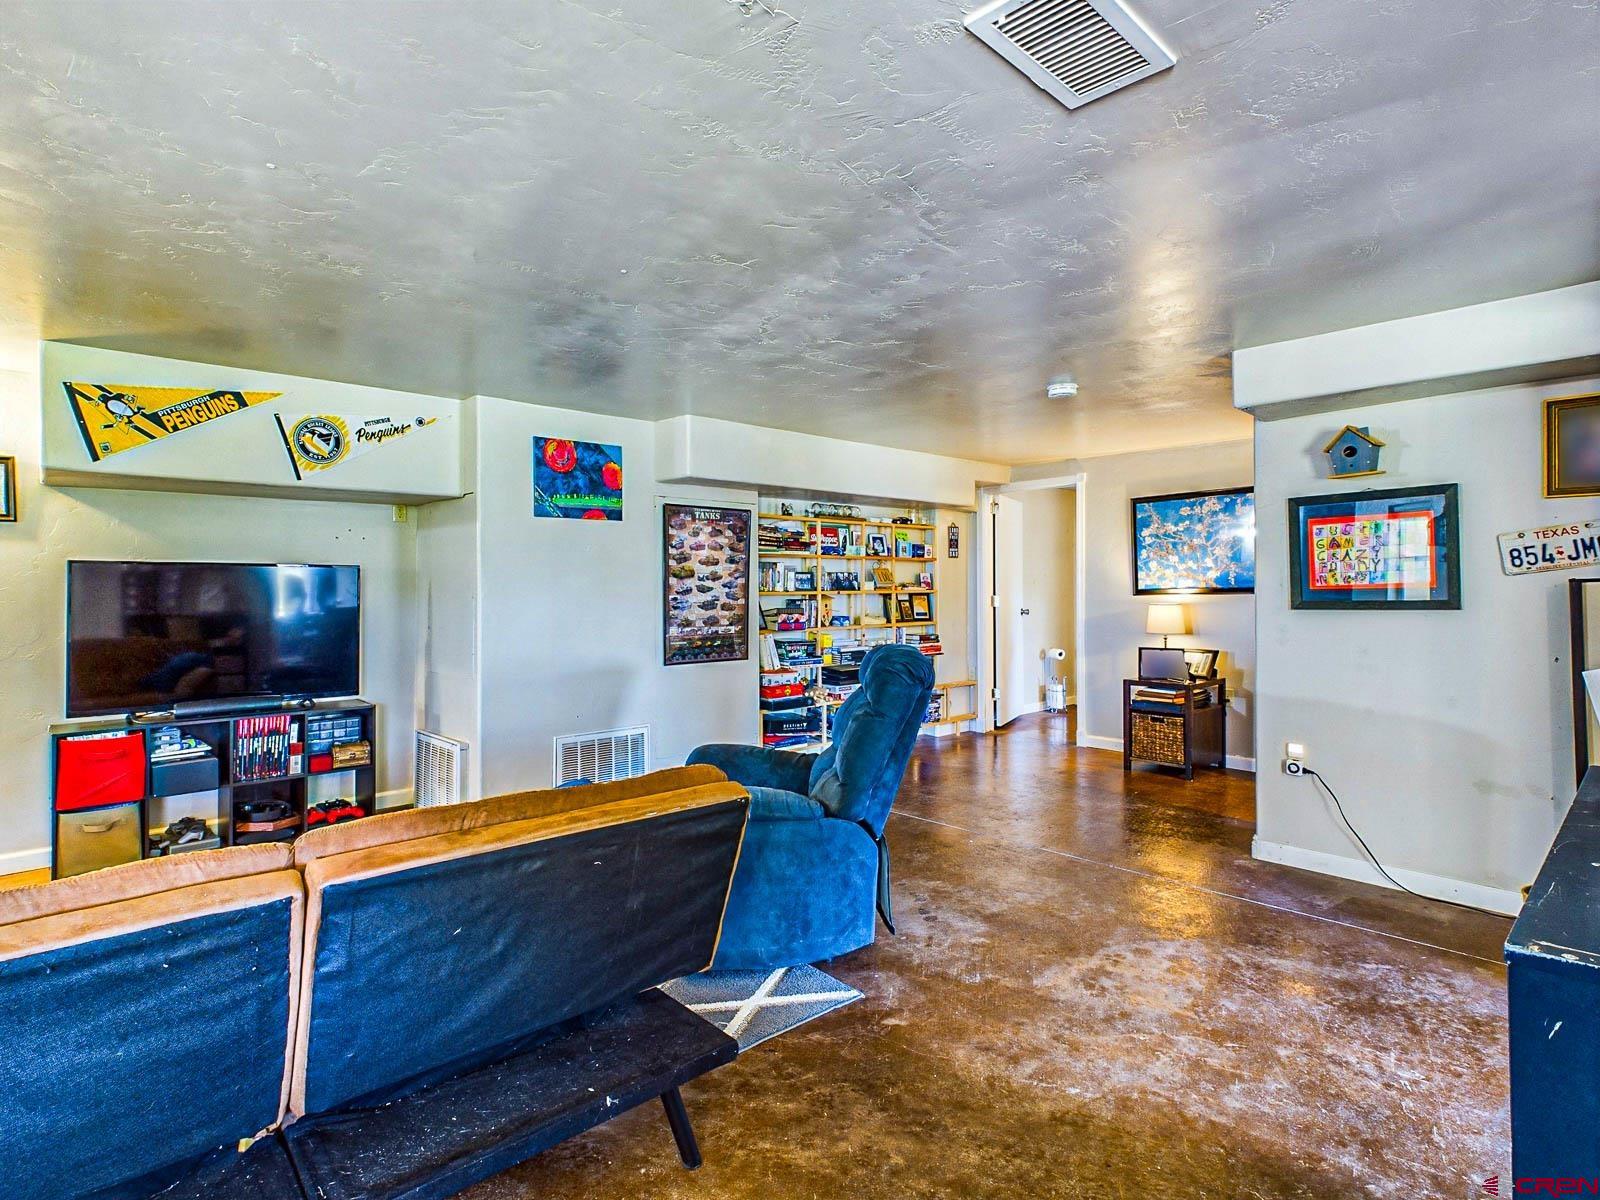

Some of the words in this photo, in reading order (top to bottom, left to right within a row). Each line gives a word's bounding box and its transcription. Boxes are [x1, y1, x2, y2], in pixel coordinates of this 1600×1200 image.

[157, 395, 210, 417] PITTSBURGH
[160, 393, 240, 433] PENGUINS
[364, 417, 391, 427] PITTSBURGH
[355, 423, 411, 442] Penguins
[694, 511, 721, 520] TANKS
[1533, 525, 1580, 540] TEXAS
[1509, 543, 1556, 568] 854
[1567, 535, 1600, 561] JM
